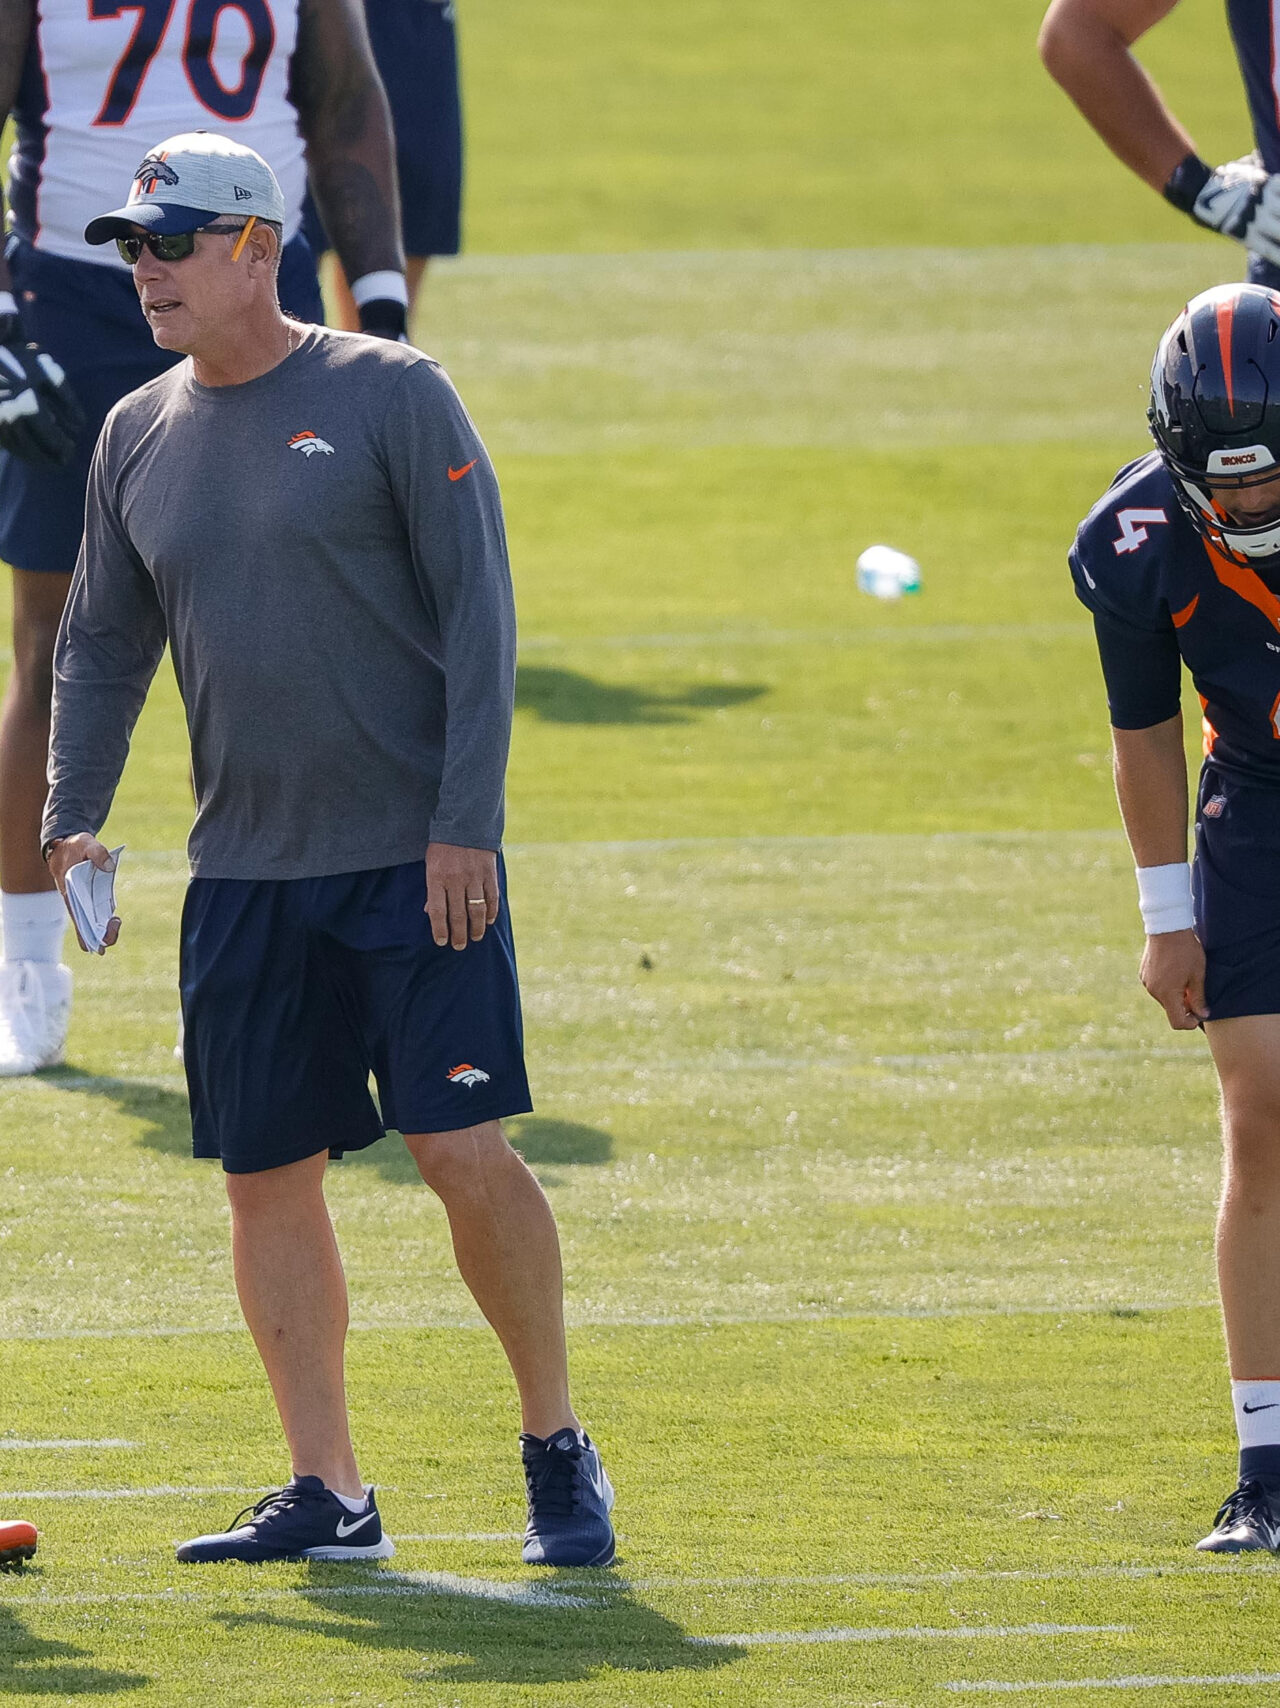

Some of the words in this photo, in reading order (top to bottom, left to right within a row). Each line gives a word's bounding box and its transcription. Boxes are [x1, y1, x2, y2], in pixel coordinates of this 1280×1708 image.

[88, 0, 276, 128] 70
[1221, 453, 1257, 466] BRONCOS
[1112, 506, 1169, 556] 4
